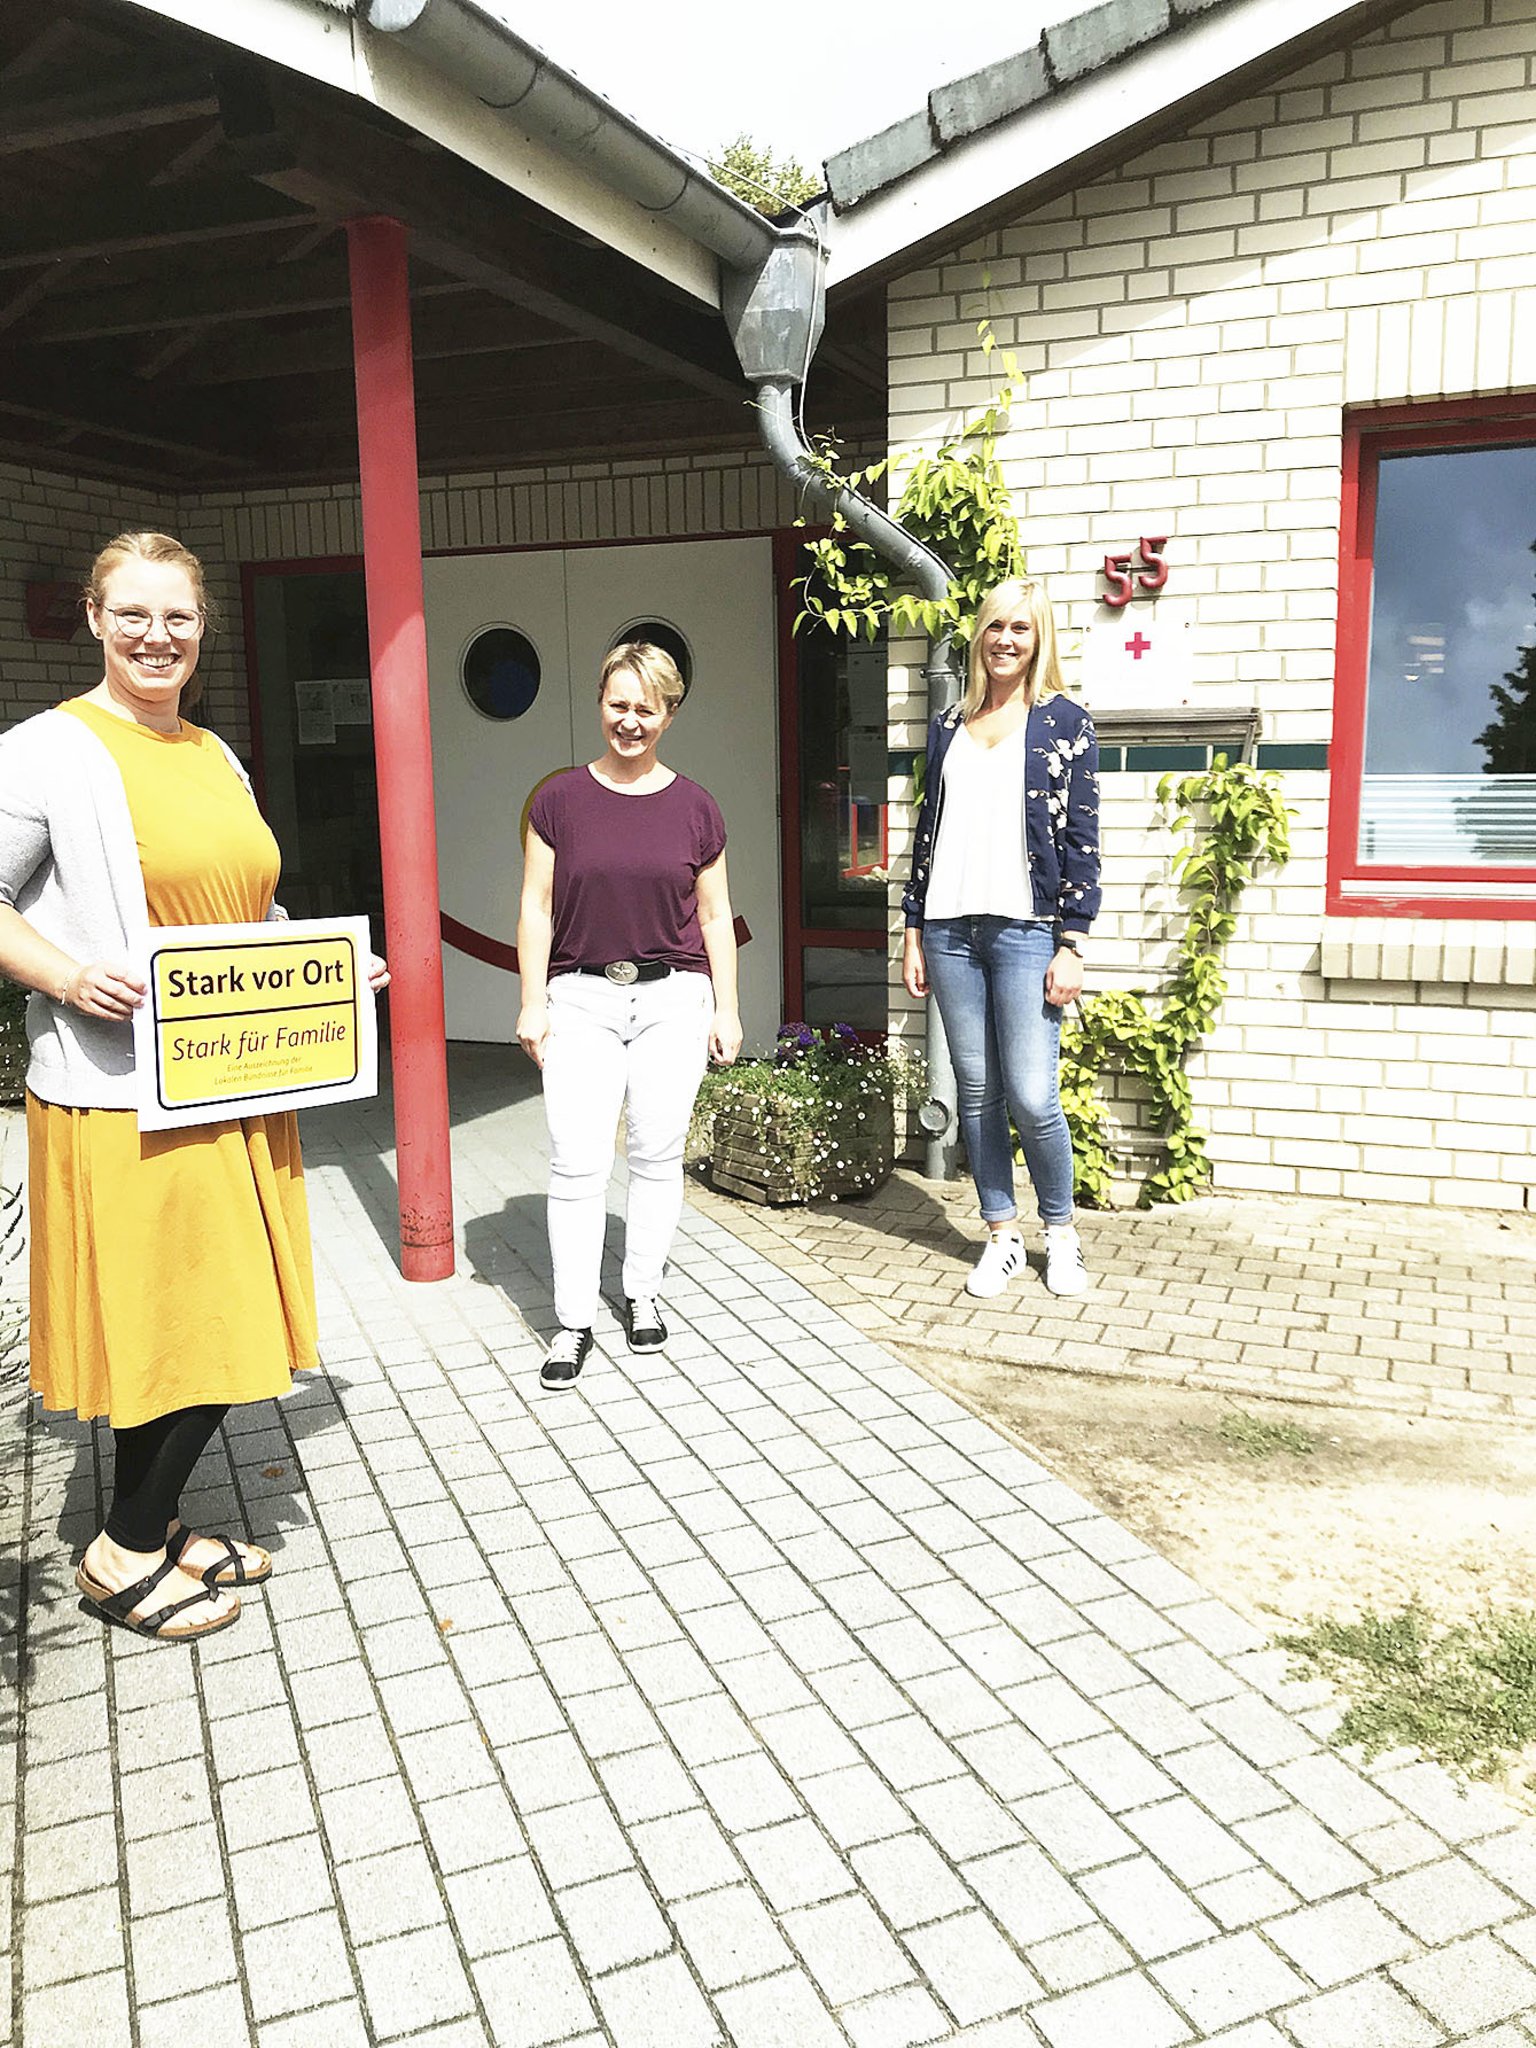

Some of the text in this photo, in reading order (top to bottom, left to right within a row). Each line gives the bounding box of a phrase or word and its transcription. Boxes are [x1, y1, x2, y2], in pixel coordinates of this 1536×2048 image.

[168, 959, 344, 997] Stark vor Ort
[172, 1020, 346, 1061] Stark für Familie
[227, 1063, 242, 1072] Eine
[290, 1056, 302, 1064] der
[214, 1075, 242, 1085] Lokalen
